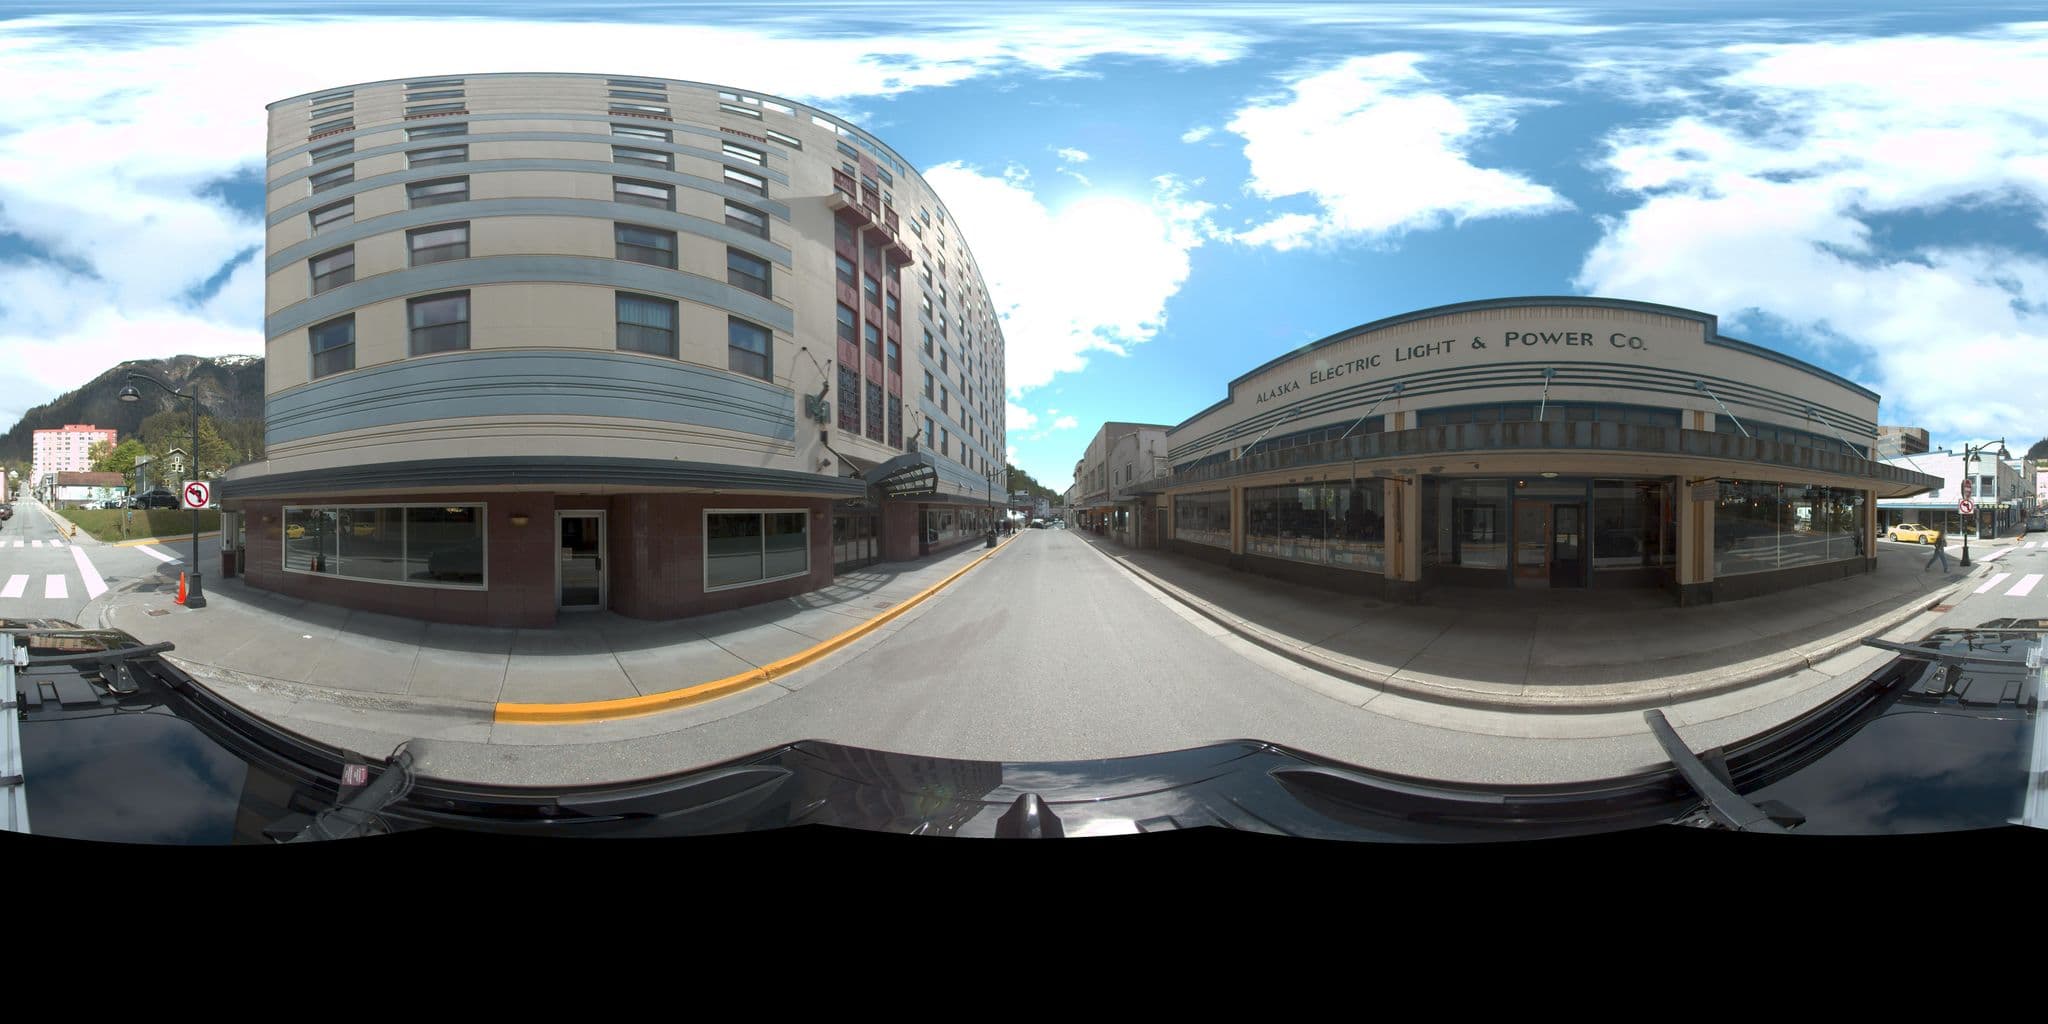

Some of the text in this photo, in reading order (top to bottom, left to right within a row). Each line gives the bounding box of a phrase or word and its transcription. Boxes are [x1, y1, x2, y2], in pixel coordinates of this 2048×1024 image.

[1255, 379, 1301, 404] ALASKA
[1309, 354, 1382, 385] ELECTRIC
[1395, 339, 1457, 362] LIGHT
[1471, 335, 1488, 350] &
[1504, 331, 1594, 347] POWER
